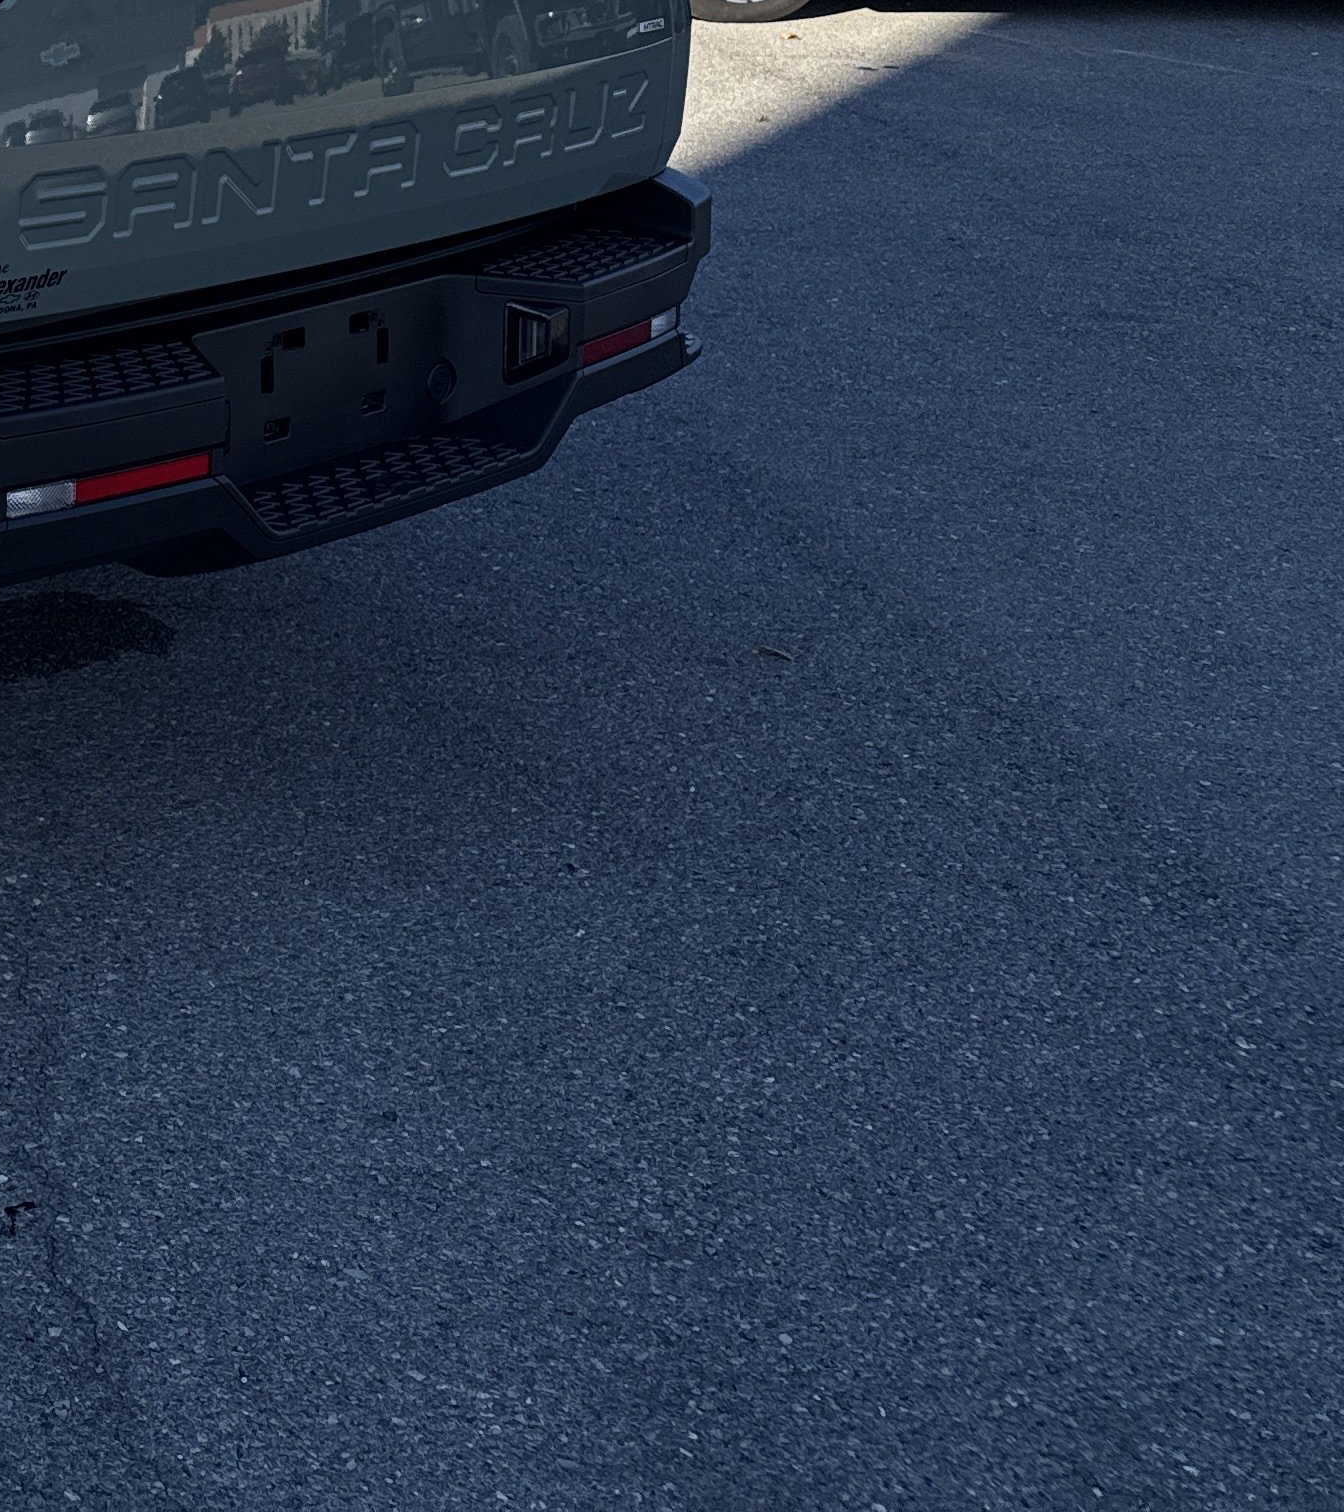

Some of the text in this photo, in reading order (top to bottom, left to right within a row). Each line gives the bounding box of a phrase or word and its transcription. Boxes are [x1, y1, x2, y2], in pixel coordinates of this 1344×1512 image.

[18, 70, 650, 251] SANTA CRUZ
[26, 301, 38, 310] PA
